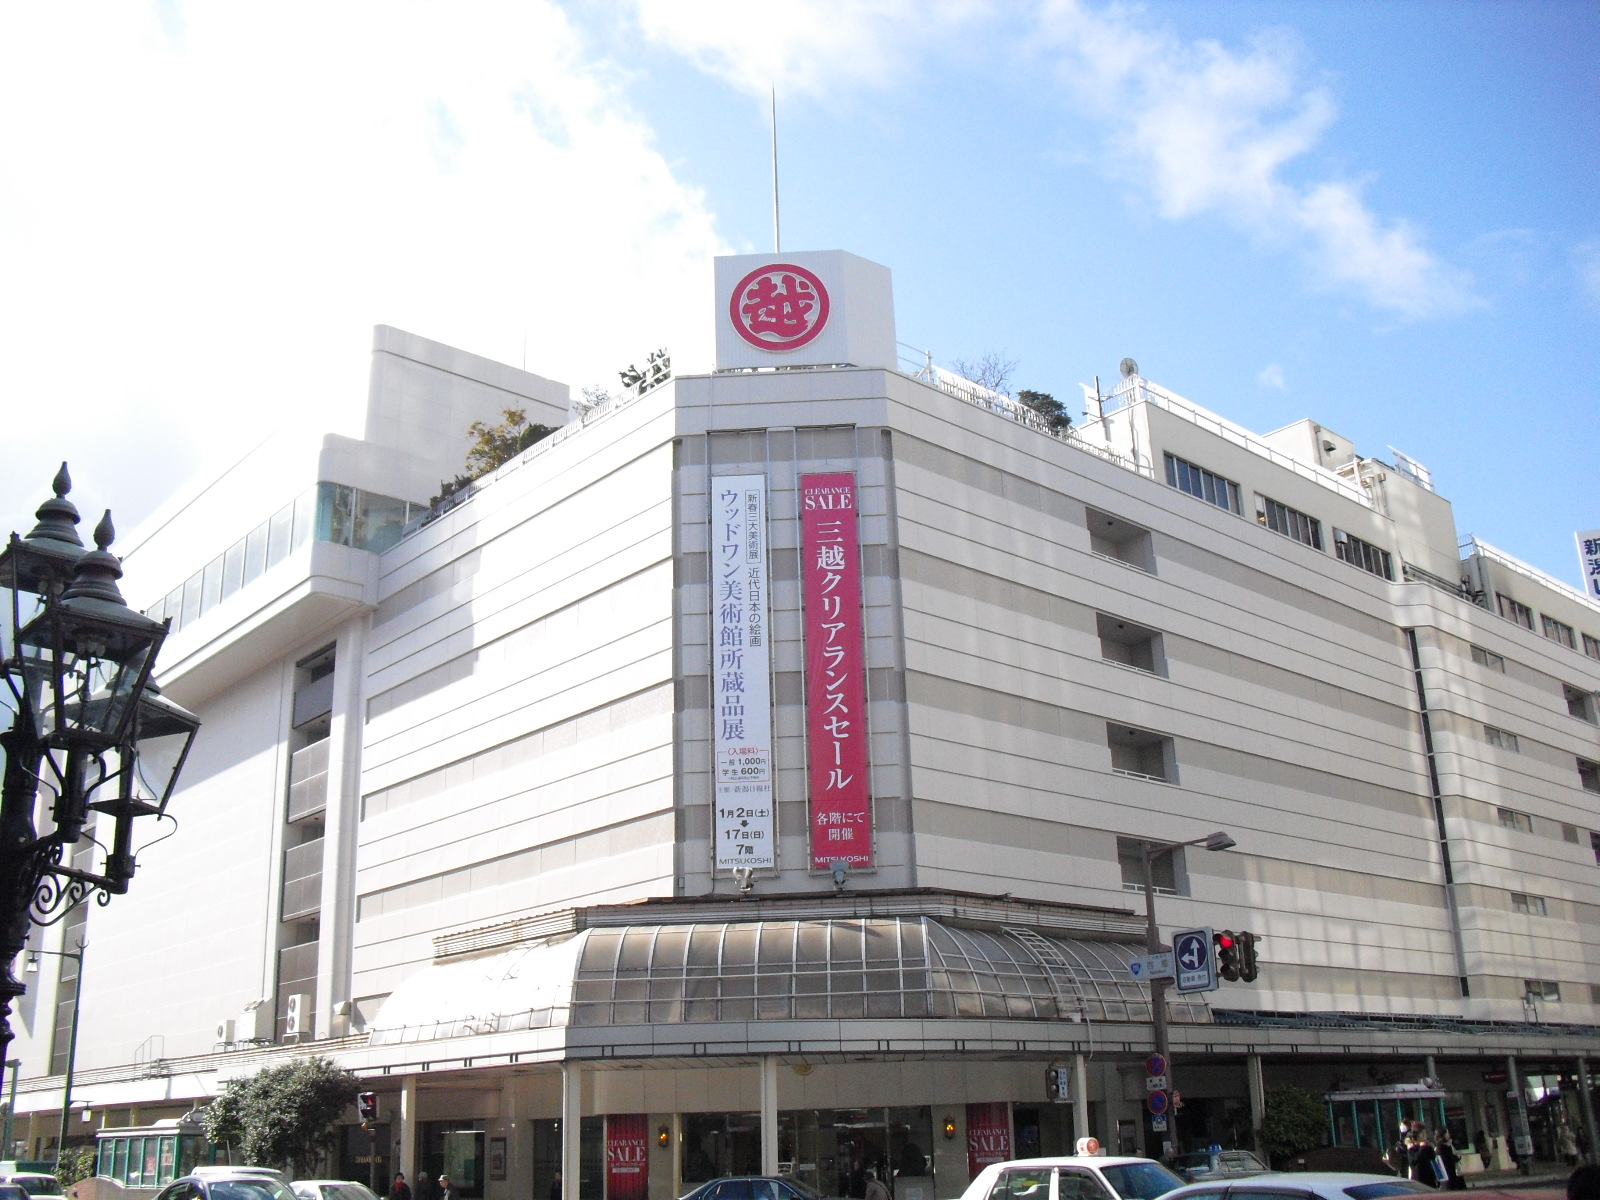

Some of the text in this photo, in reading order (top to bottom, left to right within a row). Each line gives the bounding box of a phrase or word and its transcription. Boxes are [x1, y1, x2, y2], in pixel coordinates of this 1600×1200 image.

[805, 487, 851, 495] CLEARANCE
[804, 493, 852, 511] SALE
[747, 493, 762, 647] 新春三大美術展 近代日本の絵画
[720, 489, 745, 741] ウッドワン美術館所蔵品展
[816, 520, 854, 791] 三越クリアランスセール
[720, 757, 766, 767] 一般 1,000円
[722, 767, 765, 776] 学生 600円
[719, 807, 769, 819] 1月2日(土)
[816, 811, 865, 825] 各階にて
[724, 829, 764, 840] 17日(日)
[828, 827, 854, 841] 開催
[735, 844, 754, 855] 7階
[718, 857, 772, 865] MITSUKOSHI
[814, 855, 869, 864] MITSUKOSHI
[969, 1135, 1009, 1151] SALE
[608, 1146, 646, 1162] SALE
